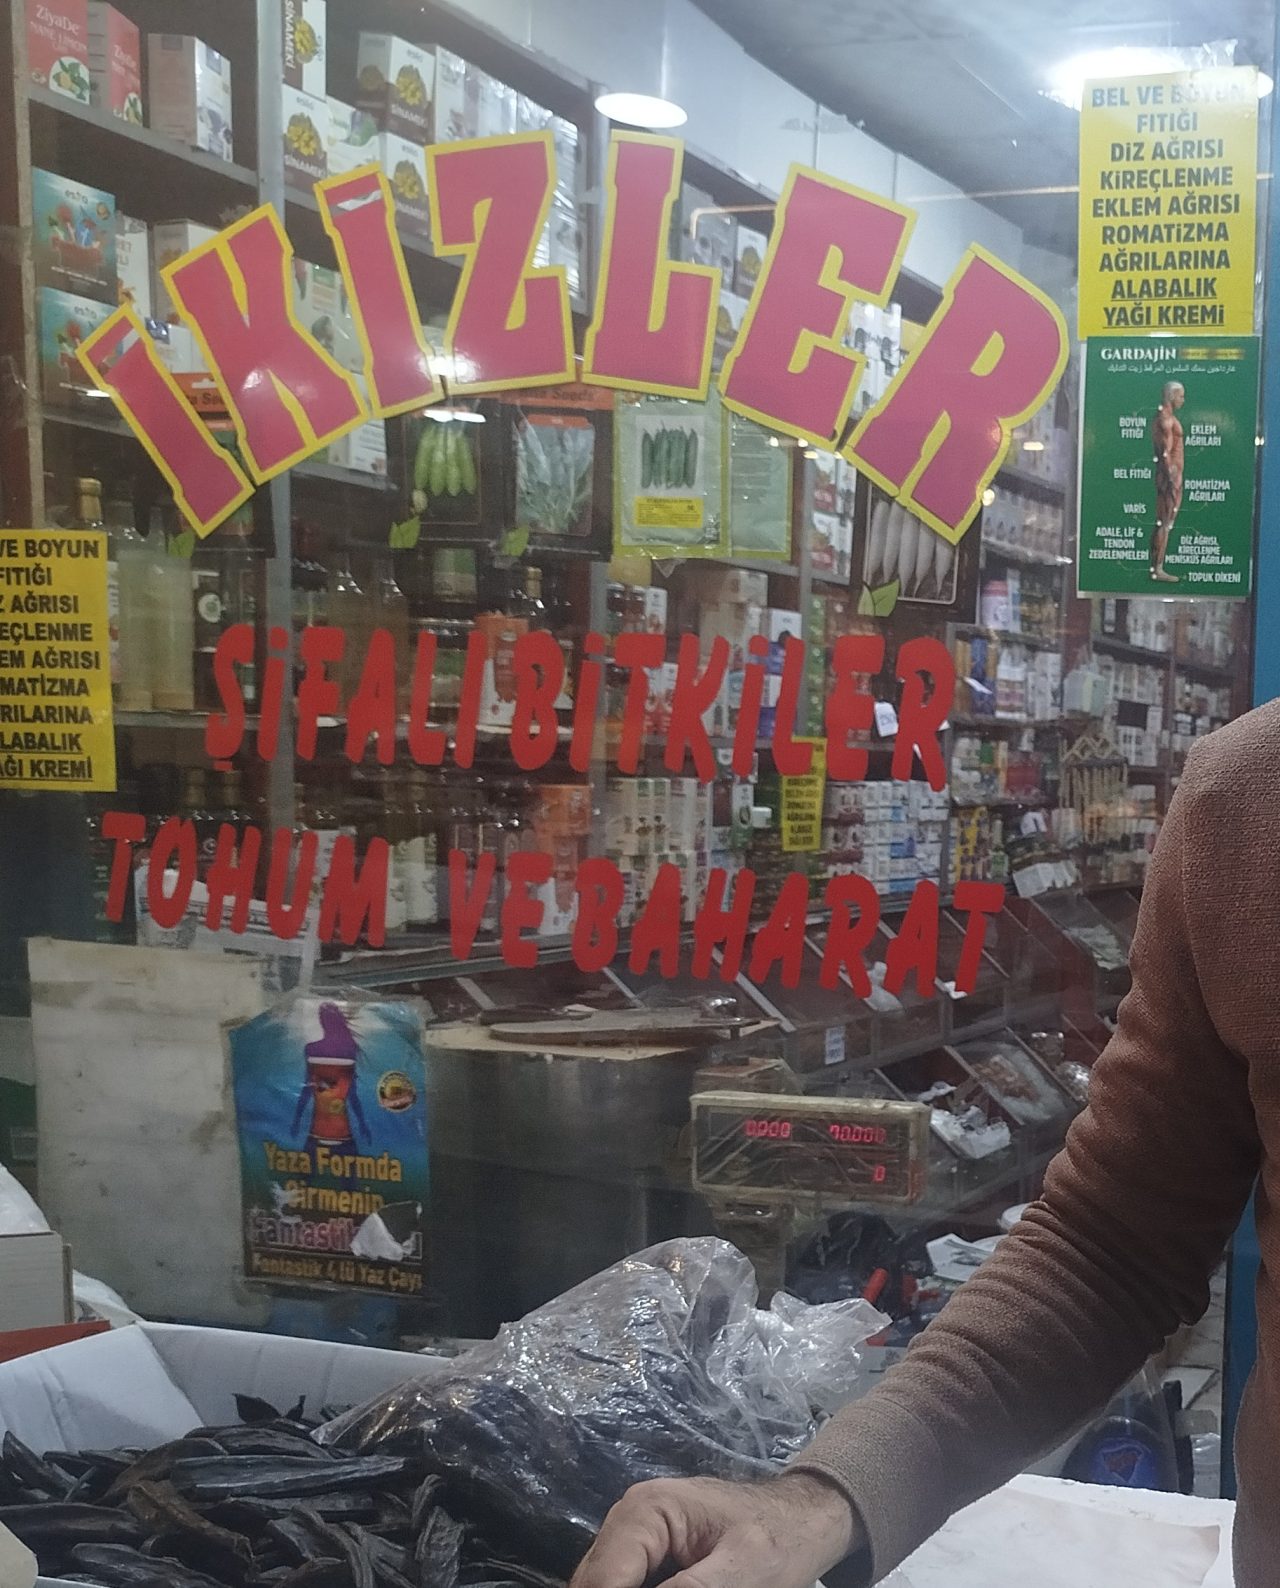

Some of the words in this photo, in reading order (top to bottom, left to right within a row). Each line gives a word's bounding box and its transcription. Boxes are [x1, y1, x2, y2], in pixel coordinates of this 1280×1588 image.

[1092, 87, 1130, 107] BEL
[1136, 85, 1164, 105] VE
[1136, 108, 1198, 133] FITIĞI
[1110, 142, 1145, 162] DİZ
[1151, 136, 1224, 160] AĞRISI
[1100, 166, 1233, 192] KİREÇLENME
[1092, 196, 1161, 218] EKLEM
[1168, 191, 1240, 215] AĞRISI
[1101, 222, 1229, 245] ROMATİZMA
[1099, 248, 1231, 272] AĞRILARINA
[1111, 277, 1217, 299] ALABALIK
[1103, 302, 1151, 326] YAĞI
[1158, 304, 1225, 325] KREMİ
[76, 129, 1070, 545] İKİZLER
[1100, 345, 1177, 363] GARDAJİN
[1119, 417, 1146, 428] BOYUN
[1191, 425, 1217, 435] EKLEM
[1121, 428, 1144, 439] FITIĞI
[1185, 435, 1221, 447] AĞRILARI
[1114, 469, 1128, 479] BEL
[1129, 468, 1151, 479] FITIĞI
[1184, 479, 1230, 491] ROMATİZMA
[1189, 491, 1225, 502] AĞRILARI
[1123, 503, 1146, 514] VARİS
[24, 539, 99, 558] BOYUN
[1104, 539, 1135, 549] TENDON
[1181, 536, 1192, 545] DİZ
[1201, 555, 1233, 565] AĞRILARI
[1188, 572, 1213, 582] TOPUK
[10, 591, 79, 614] AĞRISI
[32, 646, 101, 670] AĞRISI
[205, 624, 487, 771] ŞİFALI
[510, 632, 956, 792] BİTKİLER
[30, 756, 92, 779] KREMİ
[102, 811, 389, 948] TOHUM
[449, 849, 553, 969] VE
[571, 858, 1005, 998] BAHARAT
[263, 1140, 311, 1174] Yaza
[316, 1147, 402, 1182] Formda
[873, 1165, 886, 1182] 0
[360, 1265, 384, 1284] Yaz
